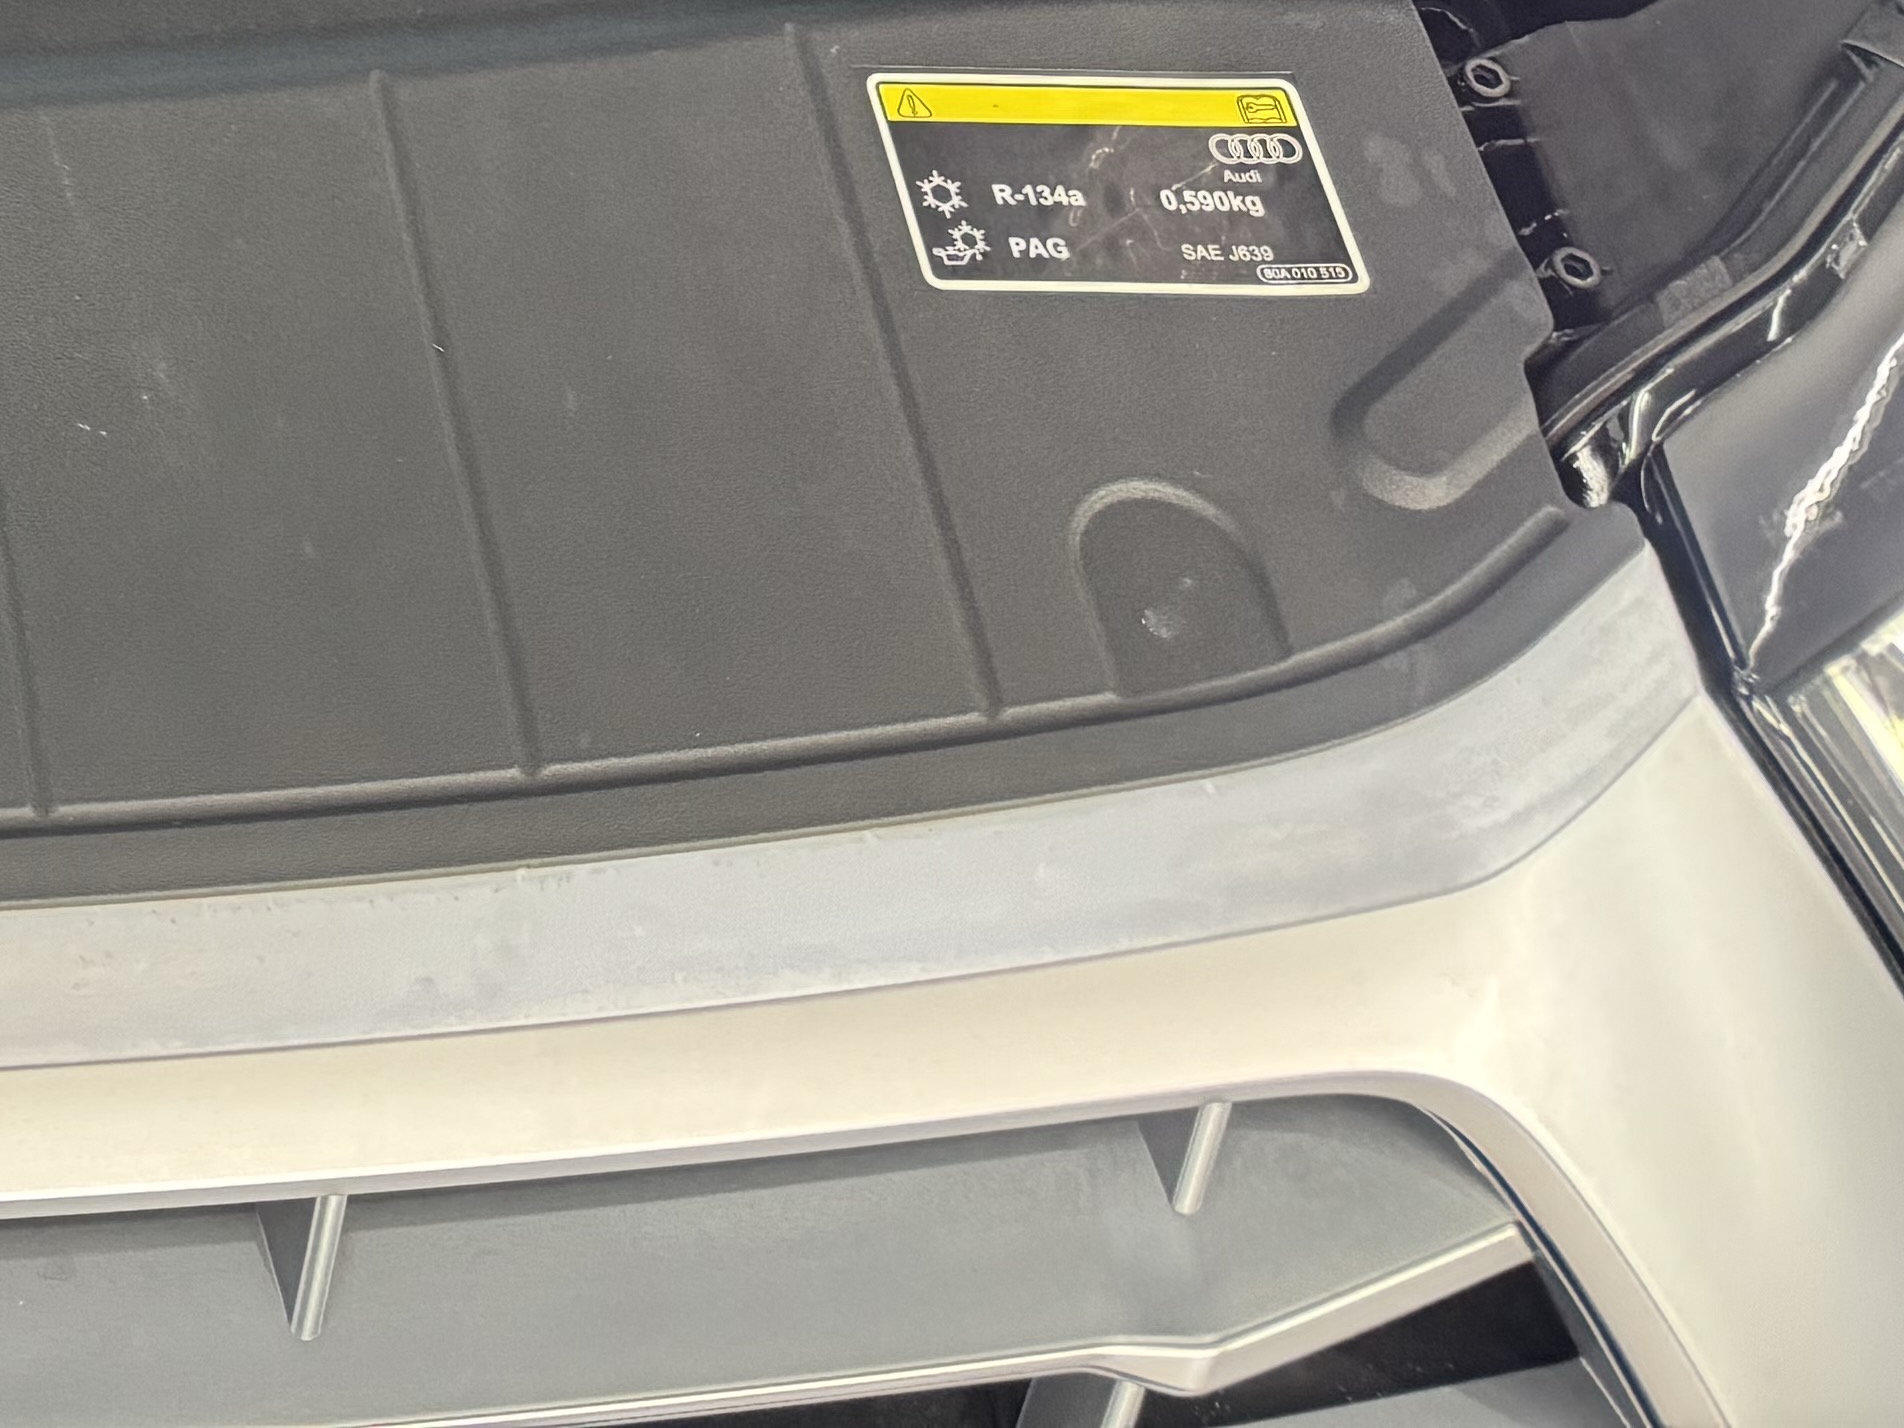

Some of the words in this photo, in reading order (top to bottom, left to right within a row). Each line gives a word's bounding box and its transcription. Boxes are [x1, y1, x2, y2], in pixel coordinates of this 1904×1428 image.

[1223, 169, 1263, 183] Audi
[991, 182, 1087, 209] R-134a
[1159, 188, 1266, 218] 0,590kg
[1008, 236, 1071, 260] PAG
[1181, 243, 1225, 262] SAE
[1229, 244, 1275, 262] J639
[1292, 267, 1318, 279] 010
